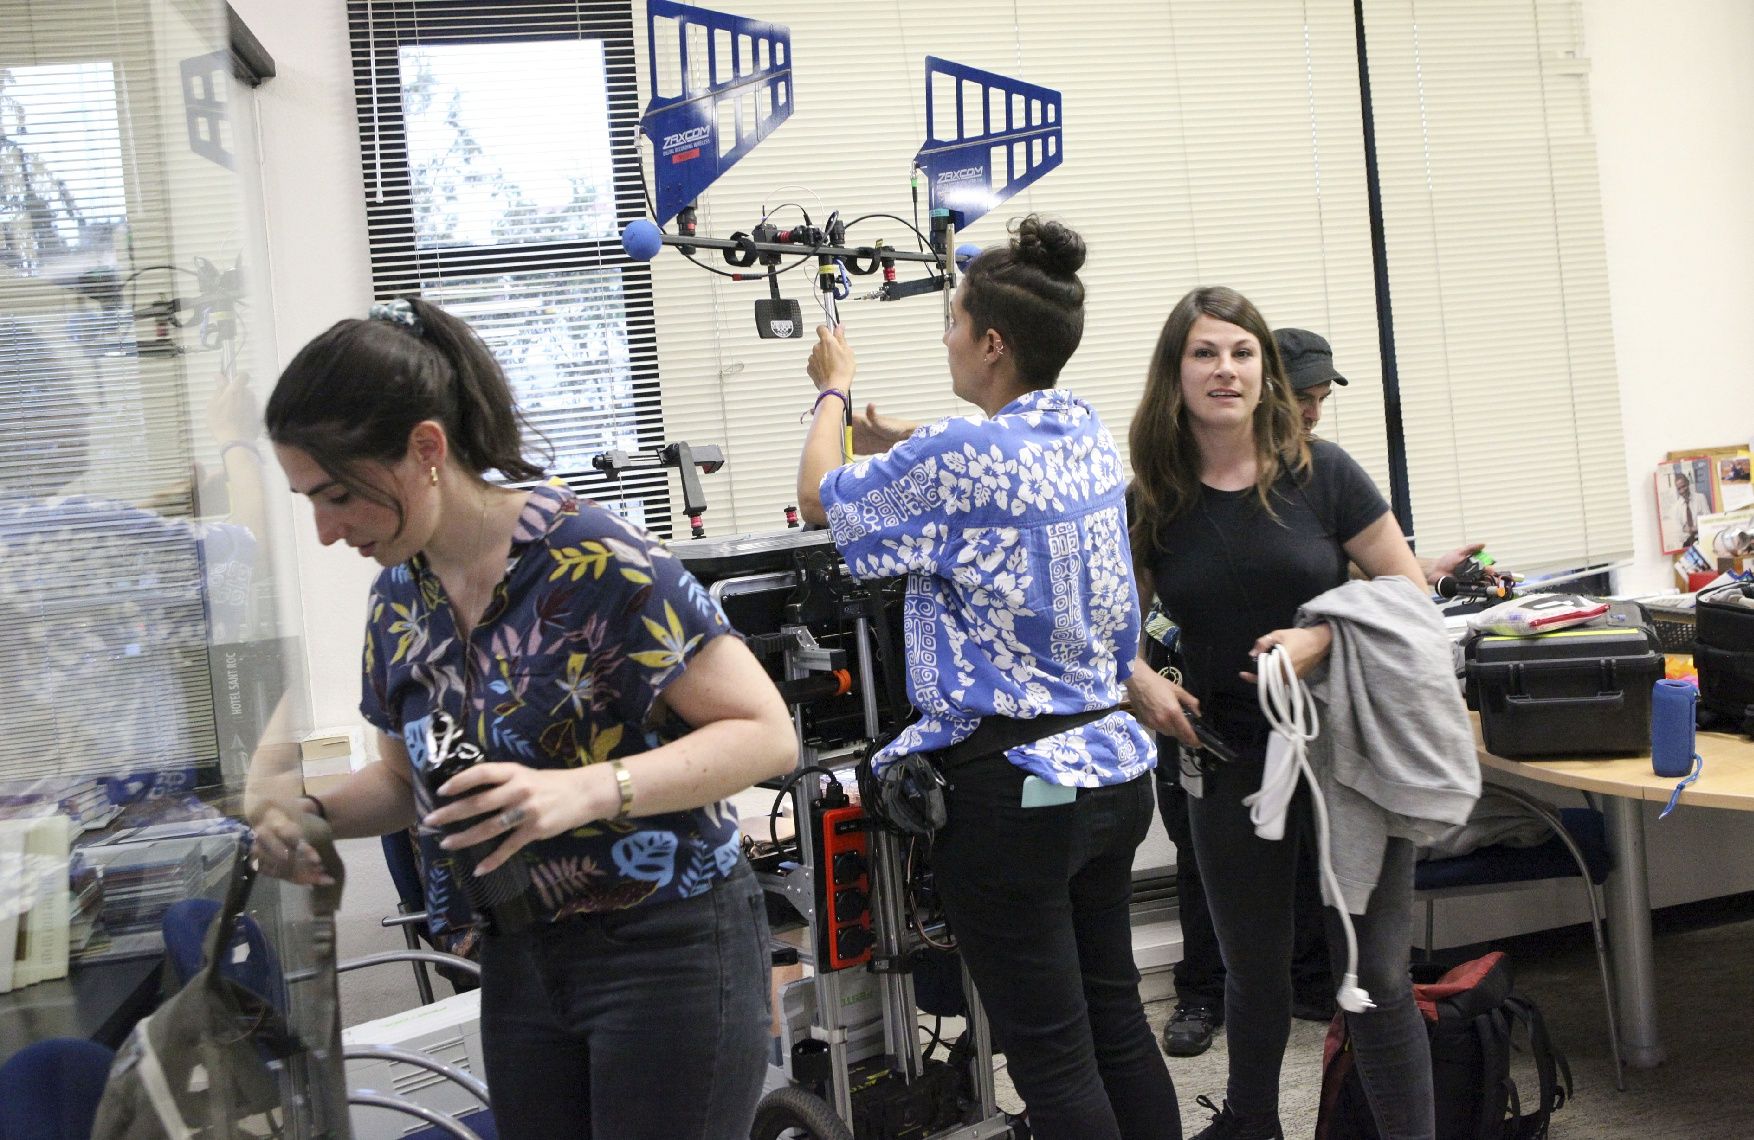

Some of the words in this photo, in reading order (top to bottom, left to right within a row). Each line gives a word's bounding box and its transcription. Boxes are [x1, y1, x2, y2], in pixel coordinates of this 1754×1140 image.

[662, 125, 710, 149] ZAXCOM
[937, 165, 983, 184] ZAXCOM
[226, 652, 236, 668] ROC
[227, 669, 239, 690] SANT
[229, 691, 241, 715] HOTEL
